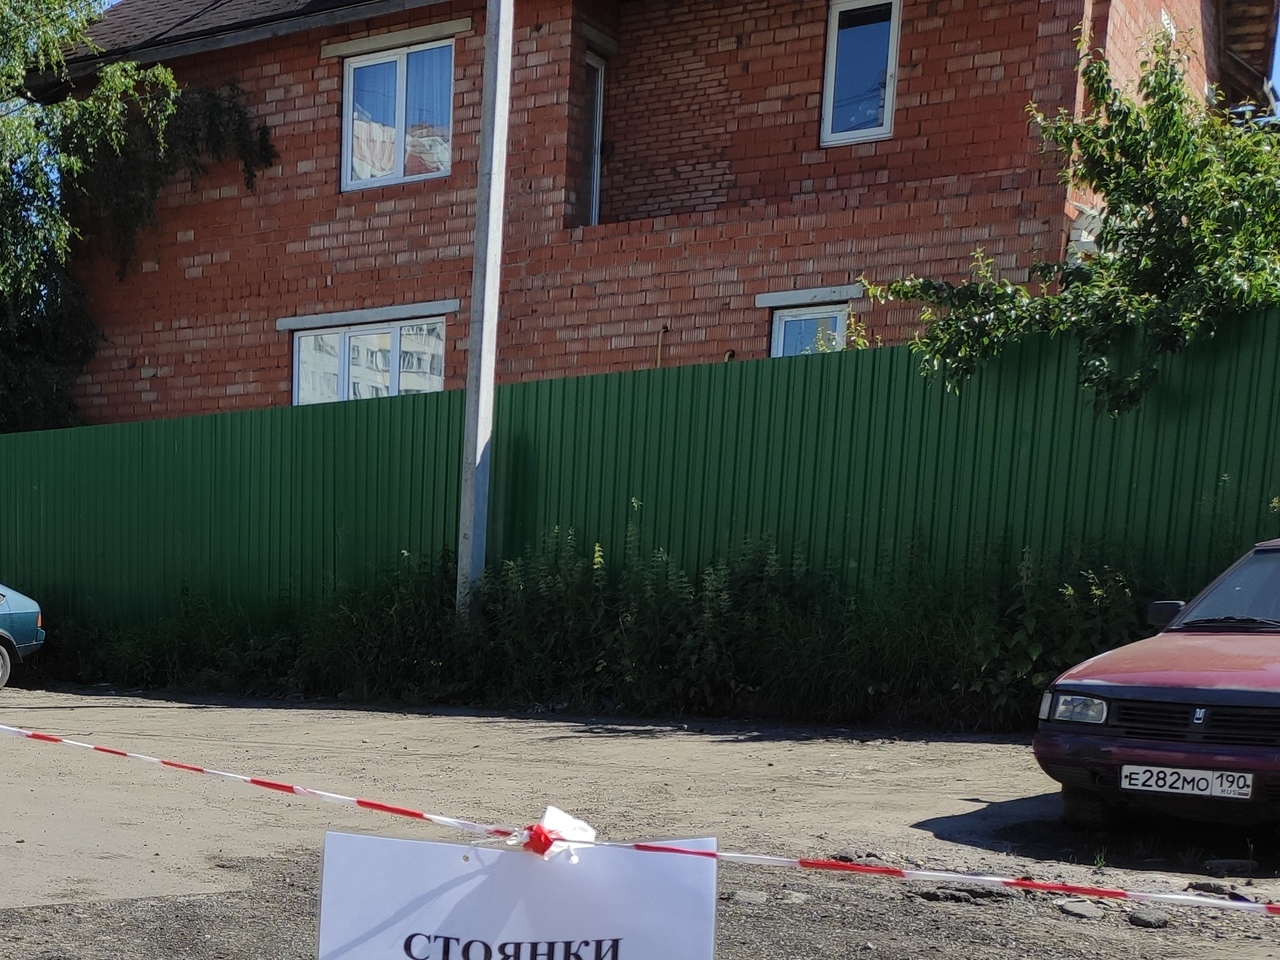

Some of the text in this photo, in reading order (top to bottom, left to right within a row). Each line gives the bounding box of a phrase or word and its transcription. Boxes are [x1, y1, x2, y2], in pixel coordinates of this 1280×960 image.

[1128, 769, 1247, 792] Е282МО 190
[1220, 788, 1237, 796] RUS
